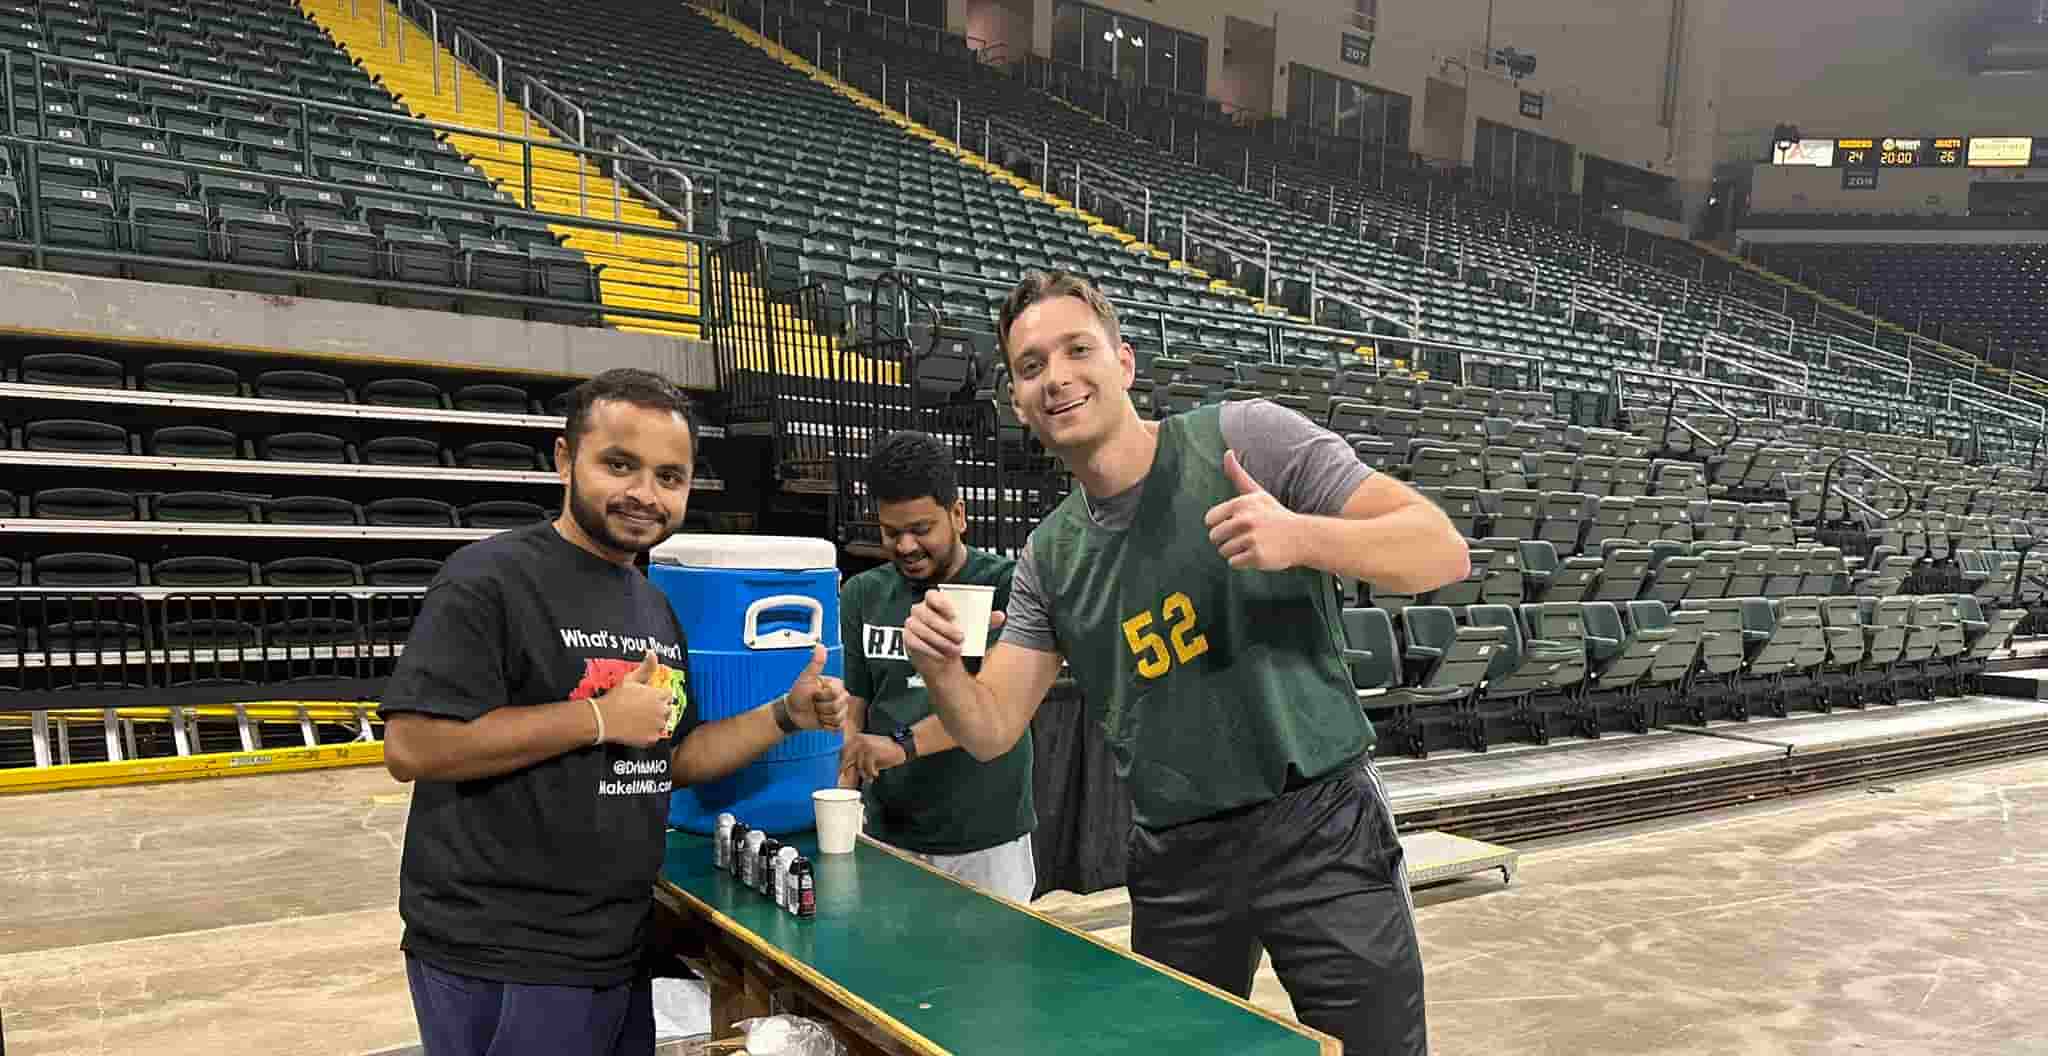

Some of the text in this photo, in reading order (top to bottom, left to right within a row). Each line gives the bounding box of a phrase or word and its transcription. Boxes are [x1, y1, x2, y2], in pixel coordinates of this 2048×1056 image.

[1848, 152, 1864, 163] 24
[1880, 151, 1912, 165] 20:00
[560, 628, 618, 649] What's
[1122, 591, 1209, 679] 52
